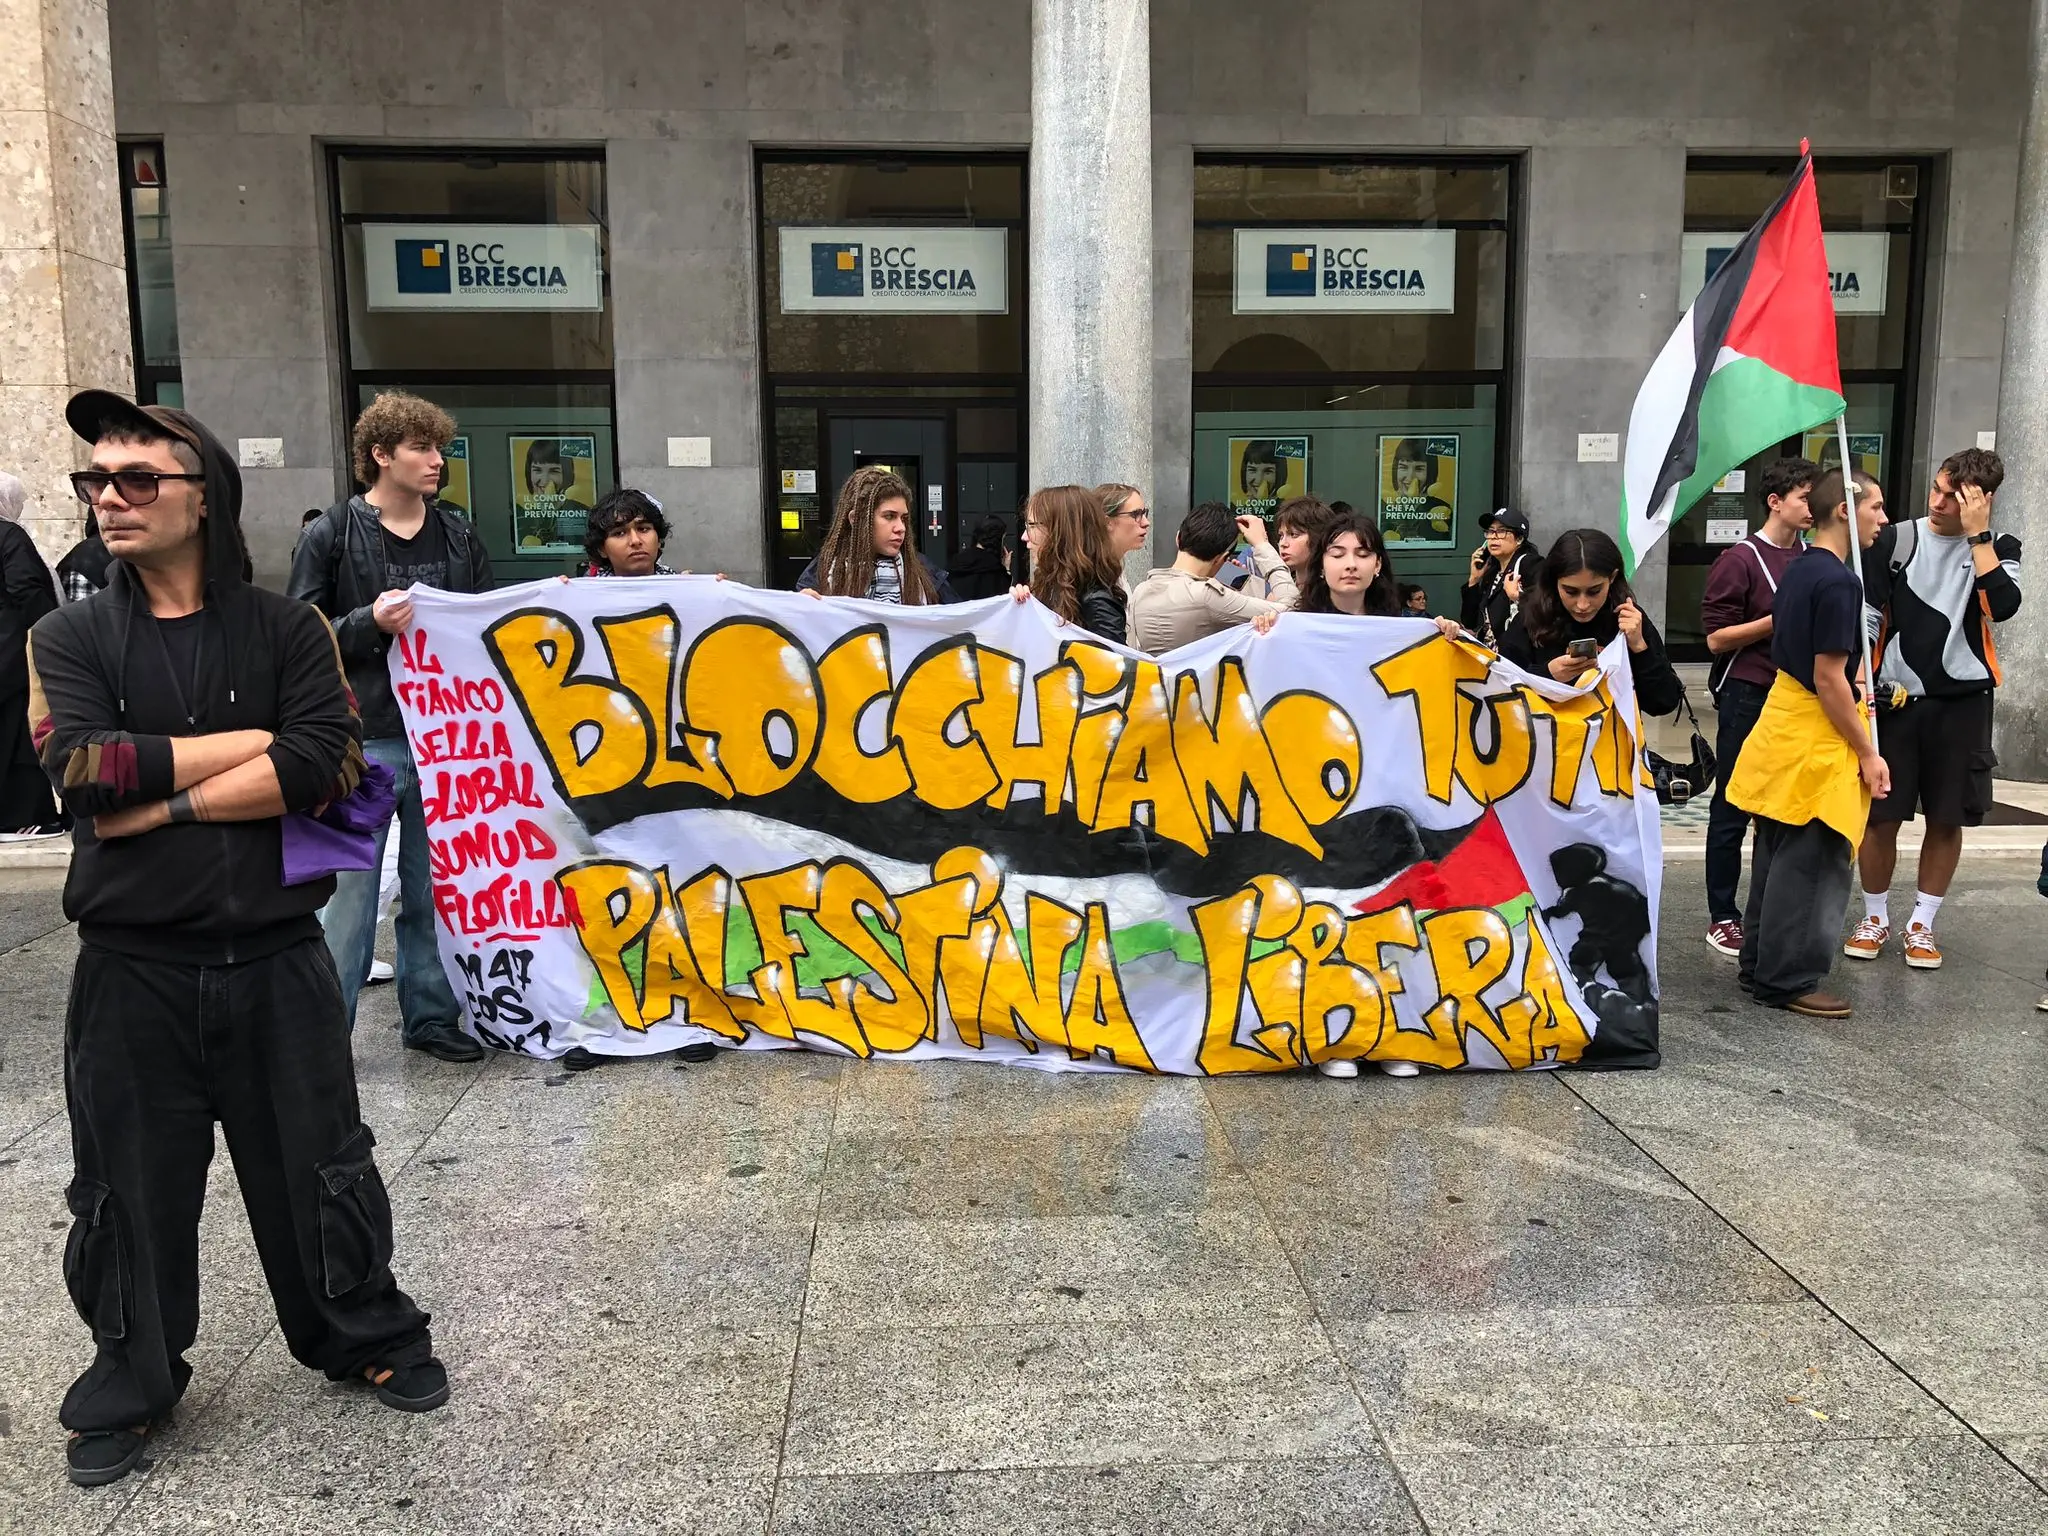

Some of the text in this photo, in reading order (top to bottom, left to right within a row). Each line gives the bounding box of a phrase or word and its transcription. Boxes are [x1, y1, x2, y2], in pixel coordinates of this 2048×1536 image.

[456, 244, 505, 265] BCC
[870, 247, 916, 268] BCC
[1323, 248, 1368, 268] BCC
[458, 265, 567, 287] BRESCIA
[870, 269, 976, 290] BRESCIA
[1323, 270, 1425, 290] BRESCIA
[459, 287, 569, 295] CREDITO COOPERATIVO ITALIANO
[524, 502, 555, 510] CHE FA
[533, 494, 566, 502] CONTO
[1245, 499, 1277, 507] CONTO
[1236, 507, 1265, 515] CHE FA
[1385, 512, 1448, 520] PREVENZIONE.
[428, 819, 557, 881] SUMUD
